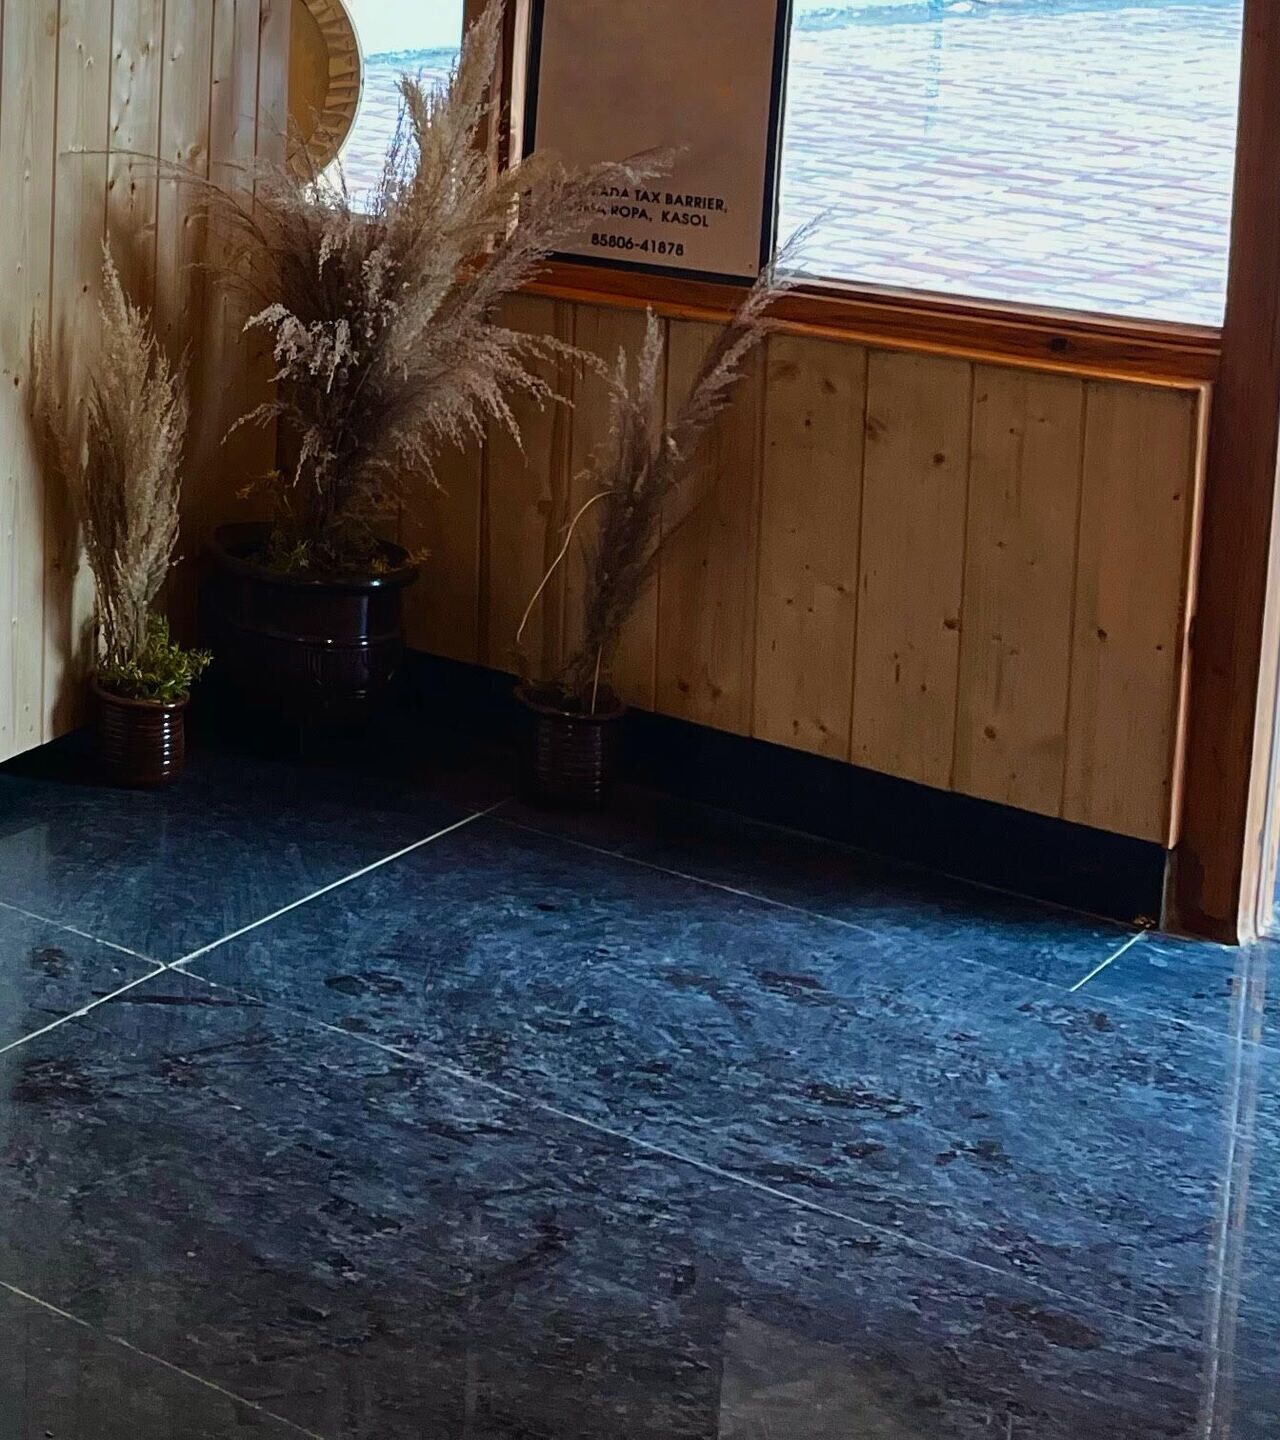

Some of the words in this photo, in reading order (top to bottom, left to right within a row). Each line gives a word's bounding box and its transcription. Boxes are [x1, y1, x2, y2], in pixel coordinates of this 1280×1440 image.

[635, 189, 661, 204] TAX
[665, 192, 728, 213] BARRIER,
[661, 210, 709, 228] KASOL
